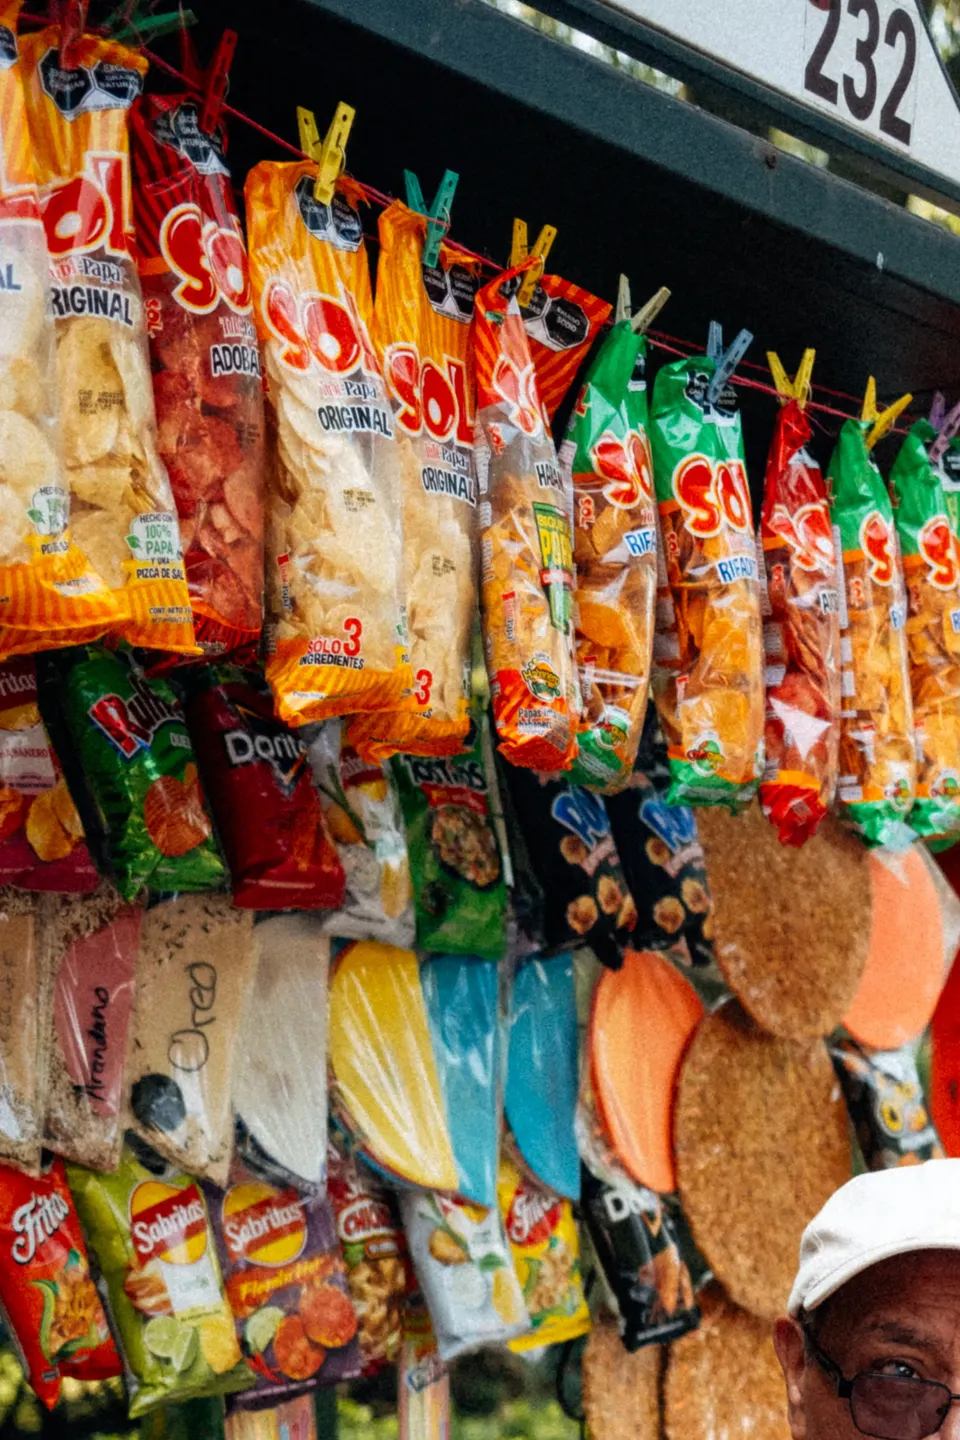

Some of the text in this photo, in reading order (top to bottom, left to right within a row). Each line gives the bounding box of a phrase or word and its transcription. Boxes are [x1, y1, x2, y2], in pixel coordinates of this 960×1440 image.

[804, 0, 917, 147] 232
[160, 203, 251, 316] SO
[50, 286, 133, 326] RIGINAL
[211, 345, 261, 375] ADOBA
[384, 344, 475, 448] SOL
[317, 404, 393, 438] ORIGINAL
[422, 466, 477, 505] ORIGINAL
[145, 525, 172, 539] 100%
[146, 541, 174, 555] PAPA
[137, 569, 185, 581] PIZCA DE SAL
[343, 617, 363, 657] 3
[299, 653, 365, 670] INGREDIENTES
[414, 668, 433, 705] 3
[224, 730, 306, 765] Dorit
[133, 1200, 207, 1254] Sabritas
[225, 1200, 303, 1253] Sabritas
